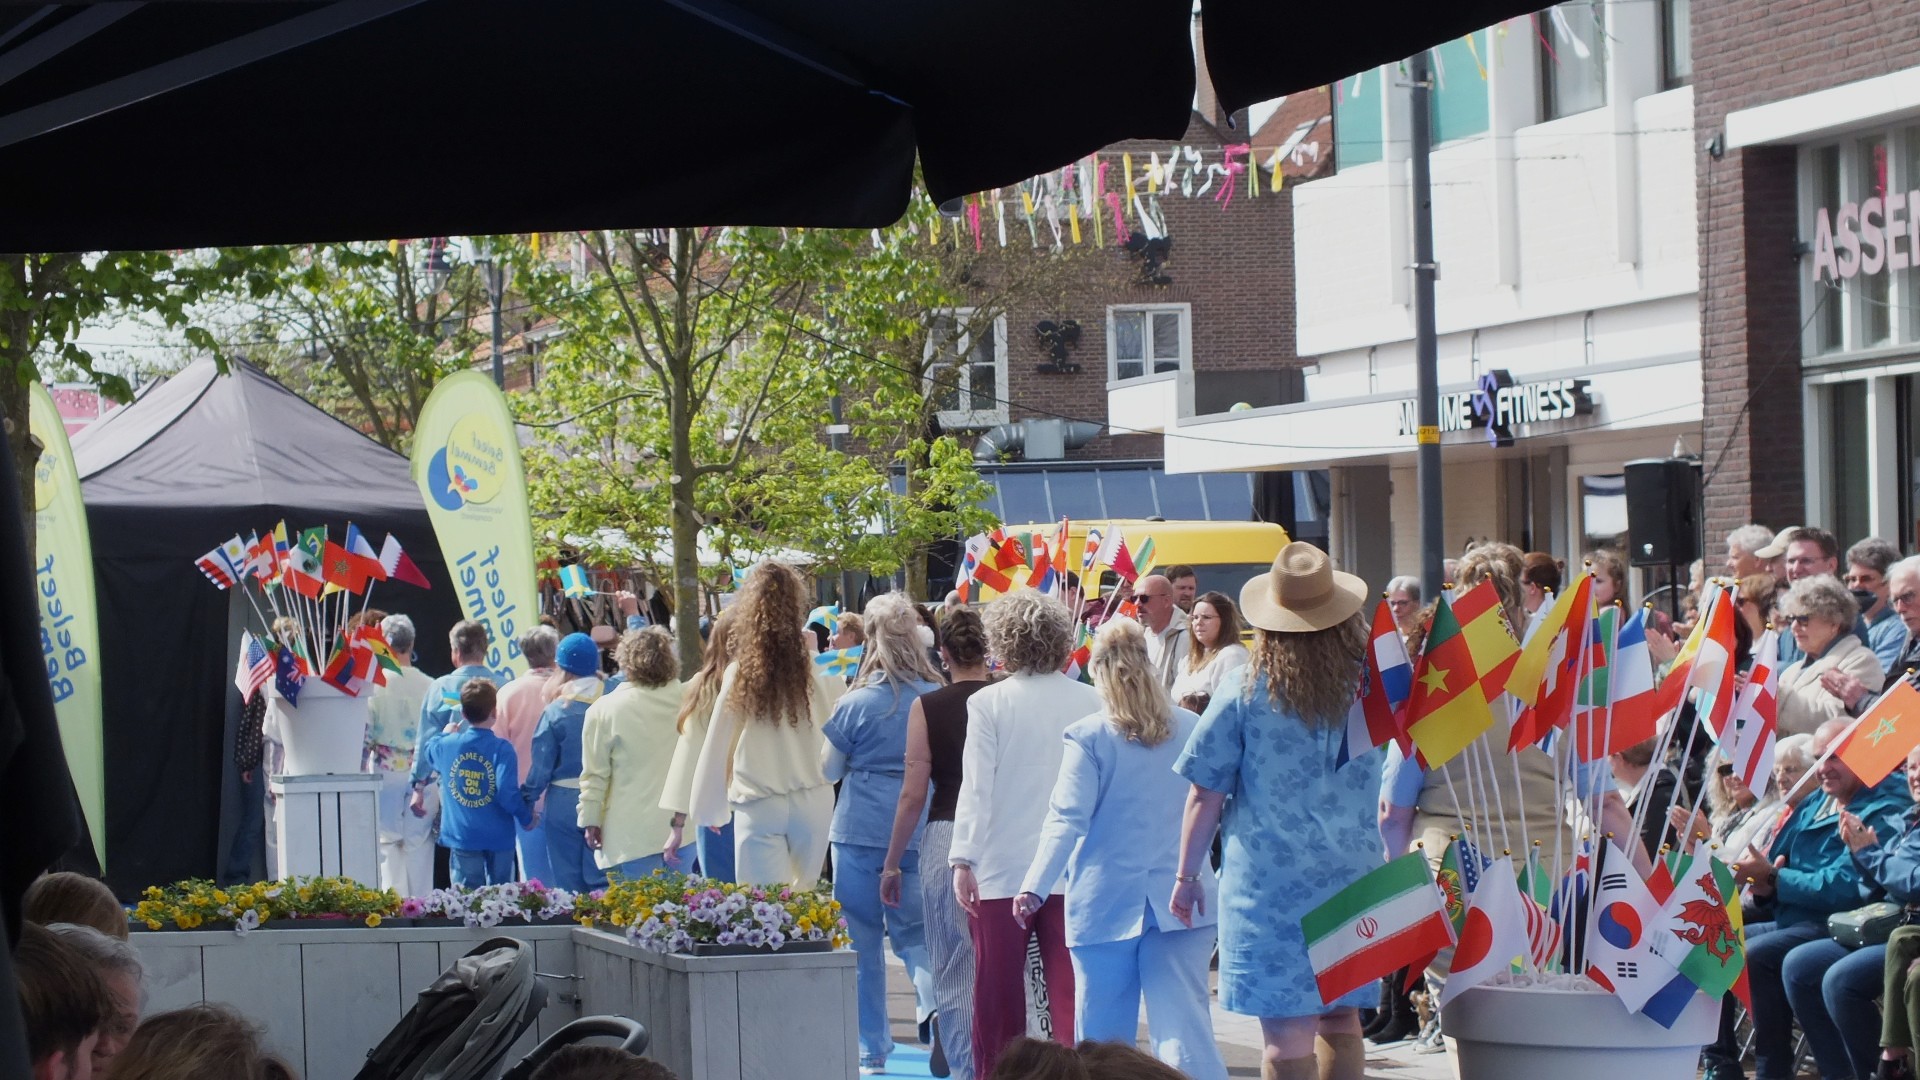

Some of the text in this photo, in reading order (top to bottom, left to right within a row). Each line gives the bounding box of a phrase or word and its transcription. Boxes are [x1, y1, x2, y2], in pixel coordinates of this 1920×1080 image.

[1399, 379, 1576, 436] ANIME FITNESS
[449, 752, 477, 777] RECLAME
[458, 769, 485, 780] PRINT
[465, 778, 479, 787] ON
[462, 786, 481, 796] YOU
